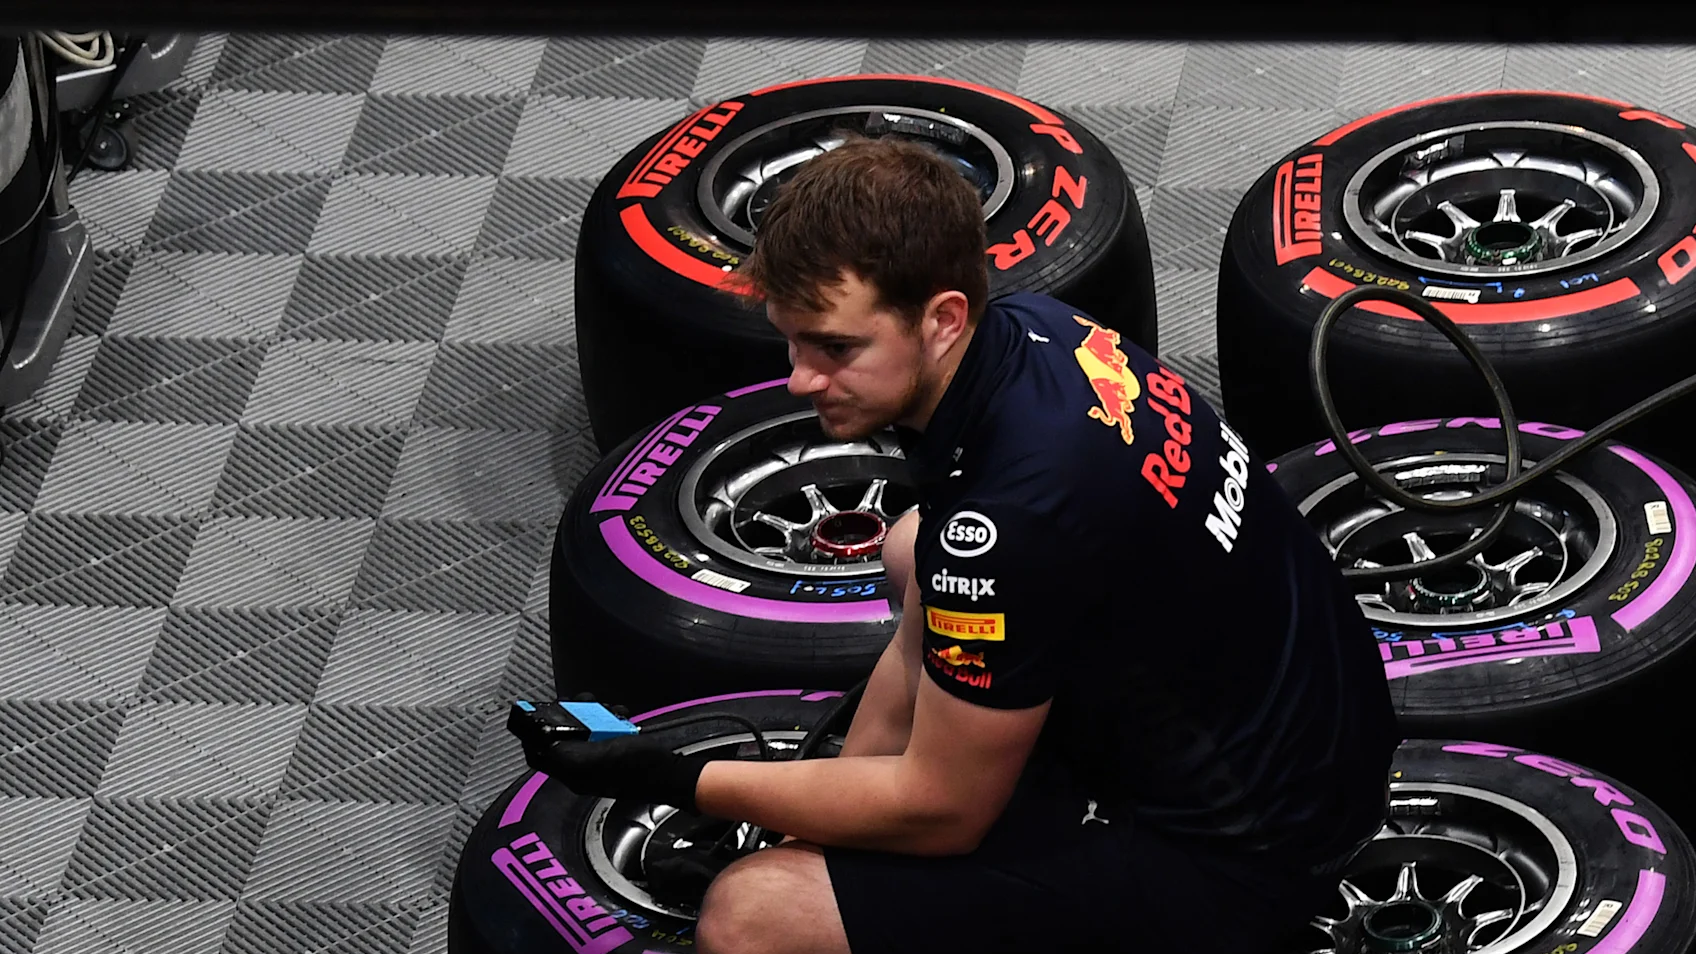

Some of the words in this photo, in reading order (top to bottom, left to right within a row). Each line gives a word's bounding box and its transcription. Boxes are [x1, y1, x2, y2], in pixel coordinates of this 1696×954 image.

[616, 101, 744, 199] PIRELLI
[1030, 122, 1082, 154] P
[1618, 109, 1686, 130] P
[985, 165, 1087, 271] ZER
[1273, 153, 1324, 266] PIRELLI
[589, 404, 723, 514] PIRELLI
[1140, 396, 1193, 509] Red
[930, 609, 997, 635] PIRELLI
[955, 666, 993, 690] Bull
[1442, 740, 1667, 855] ZERO
